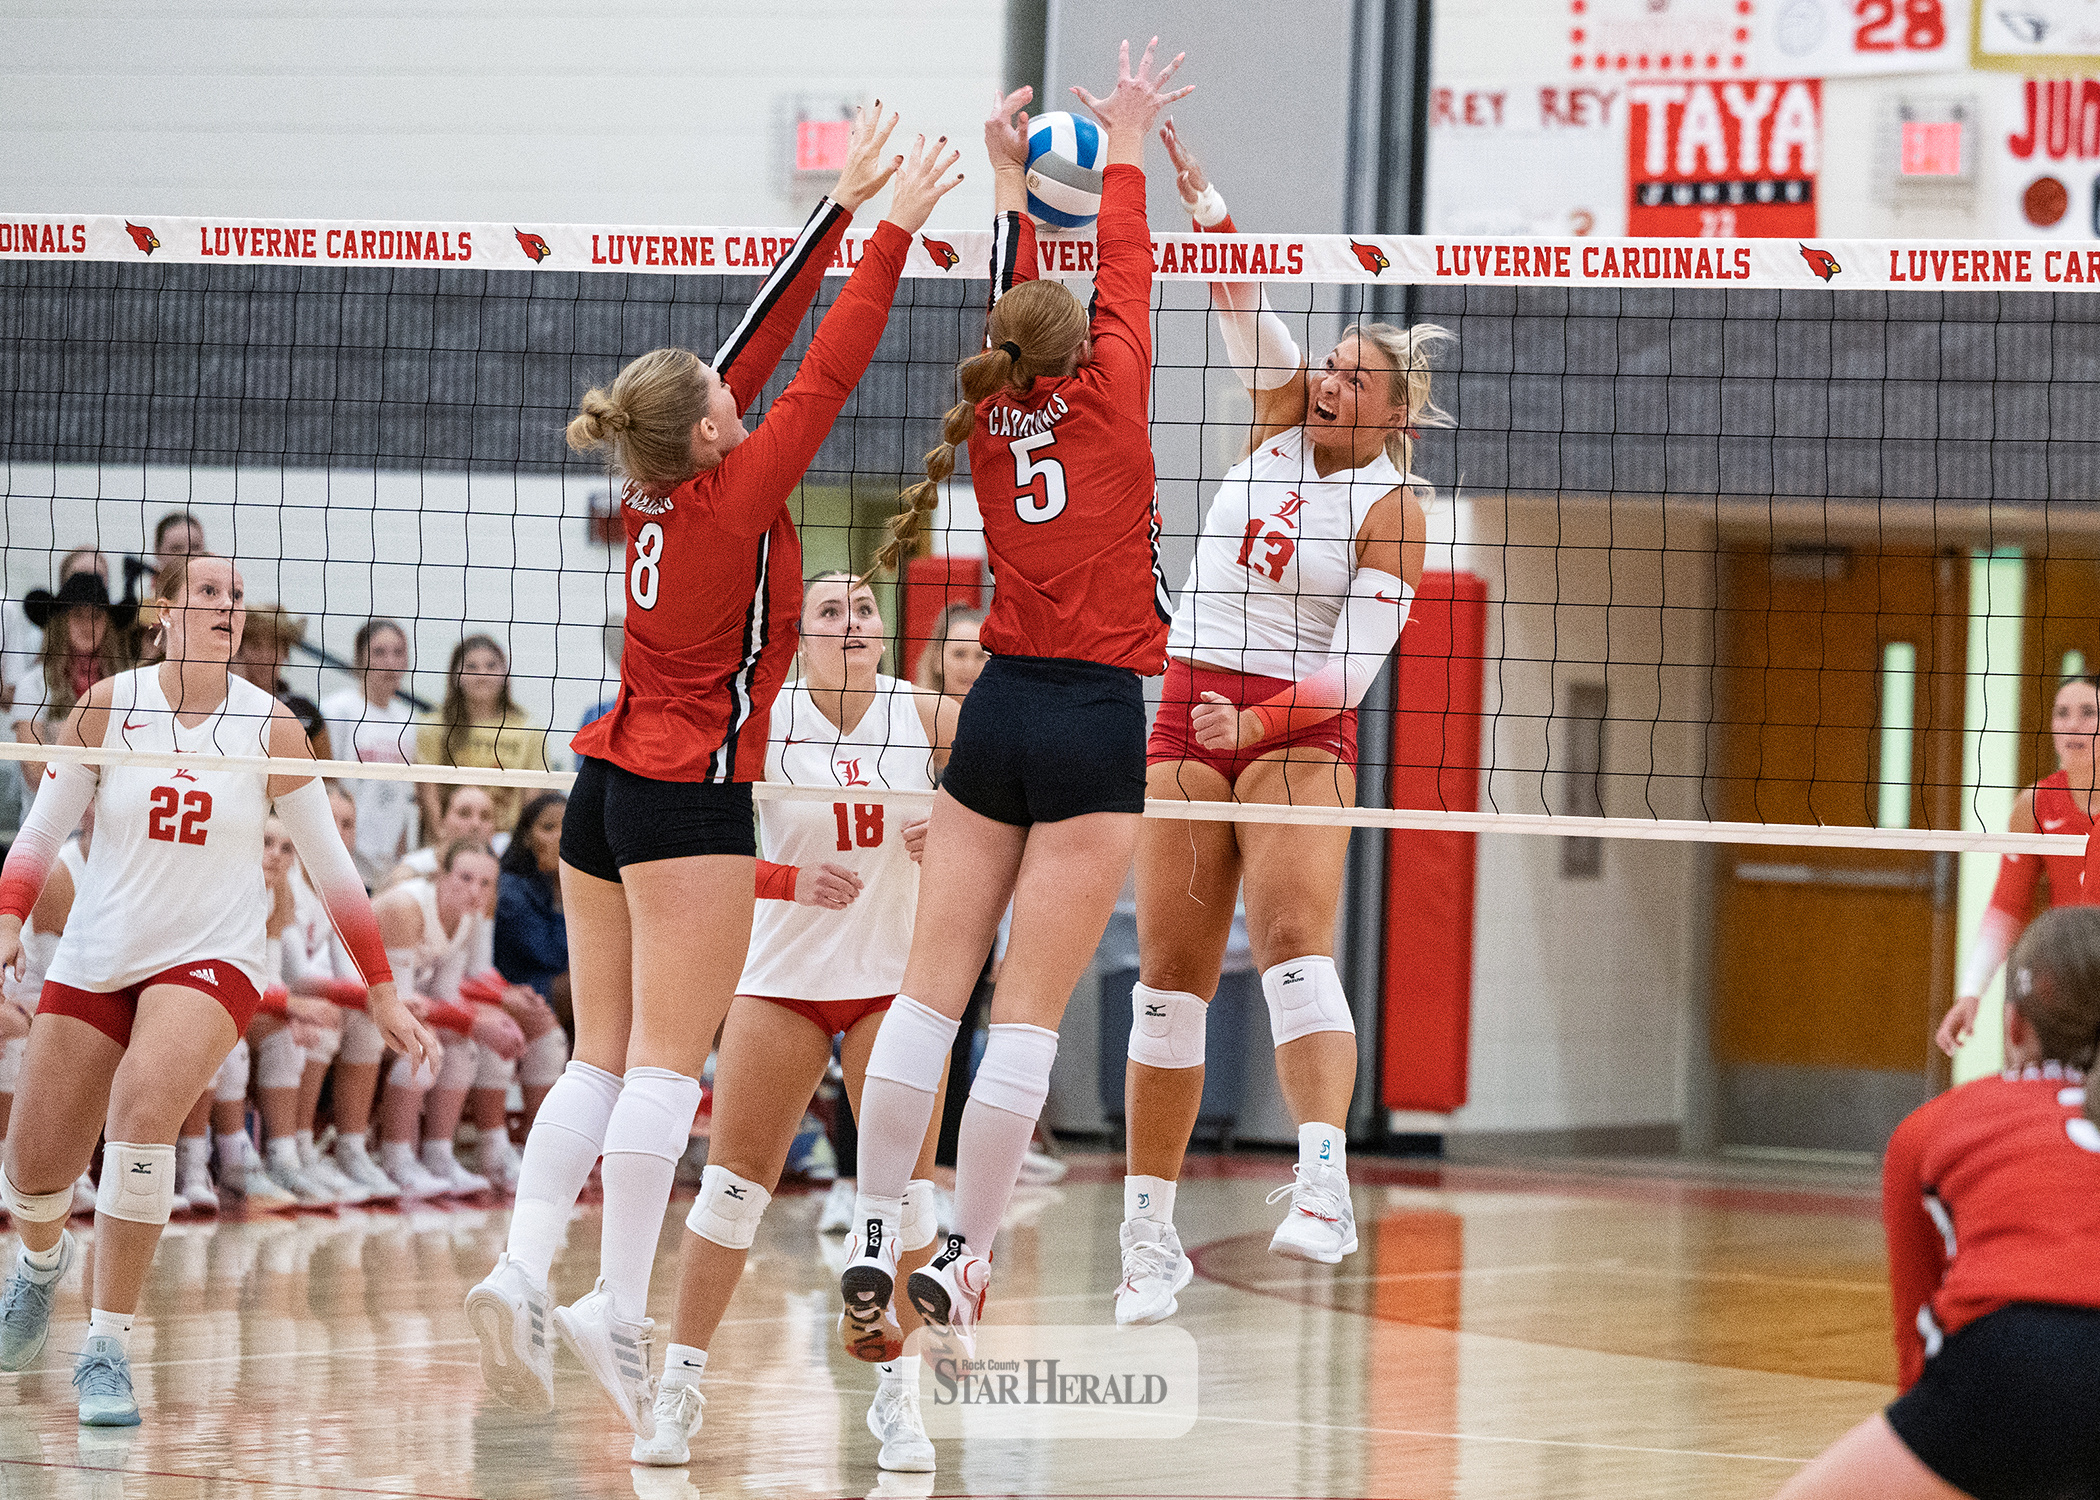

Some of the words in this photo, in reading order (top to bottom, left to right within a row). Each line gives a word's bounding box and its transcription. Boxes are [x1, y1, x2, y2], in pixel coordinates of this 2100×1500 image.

[1855, 0, 1946, 52] 28
[1632, 84, 1821, 176] TAYA
[0, 223, 86, 253] DINALS
[200, 226, 317, 259] LUVERNE
[326, 229, 472, 261] CARDINALS
[591, 234, 715, 267] LUVERNE
[1435, 245, 1571, 278] LUVERNE
[1582, 246, 1751, 280] CARDINALS
[1889, 249, 2032, 283] LUVERNE
[2045, 250, 2100, 284] CAR
[1009, 429, 1068, 524] 5
[630, 521, 664, 610] 8
[1236, 518, 1296, 583] 13
[148, 785, 213, 846] 22
[833, 802, 884, 851] 18
